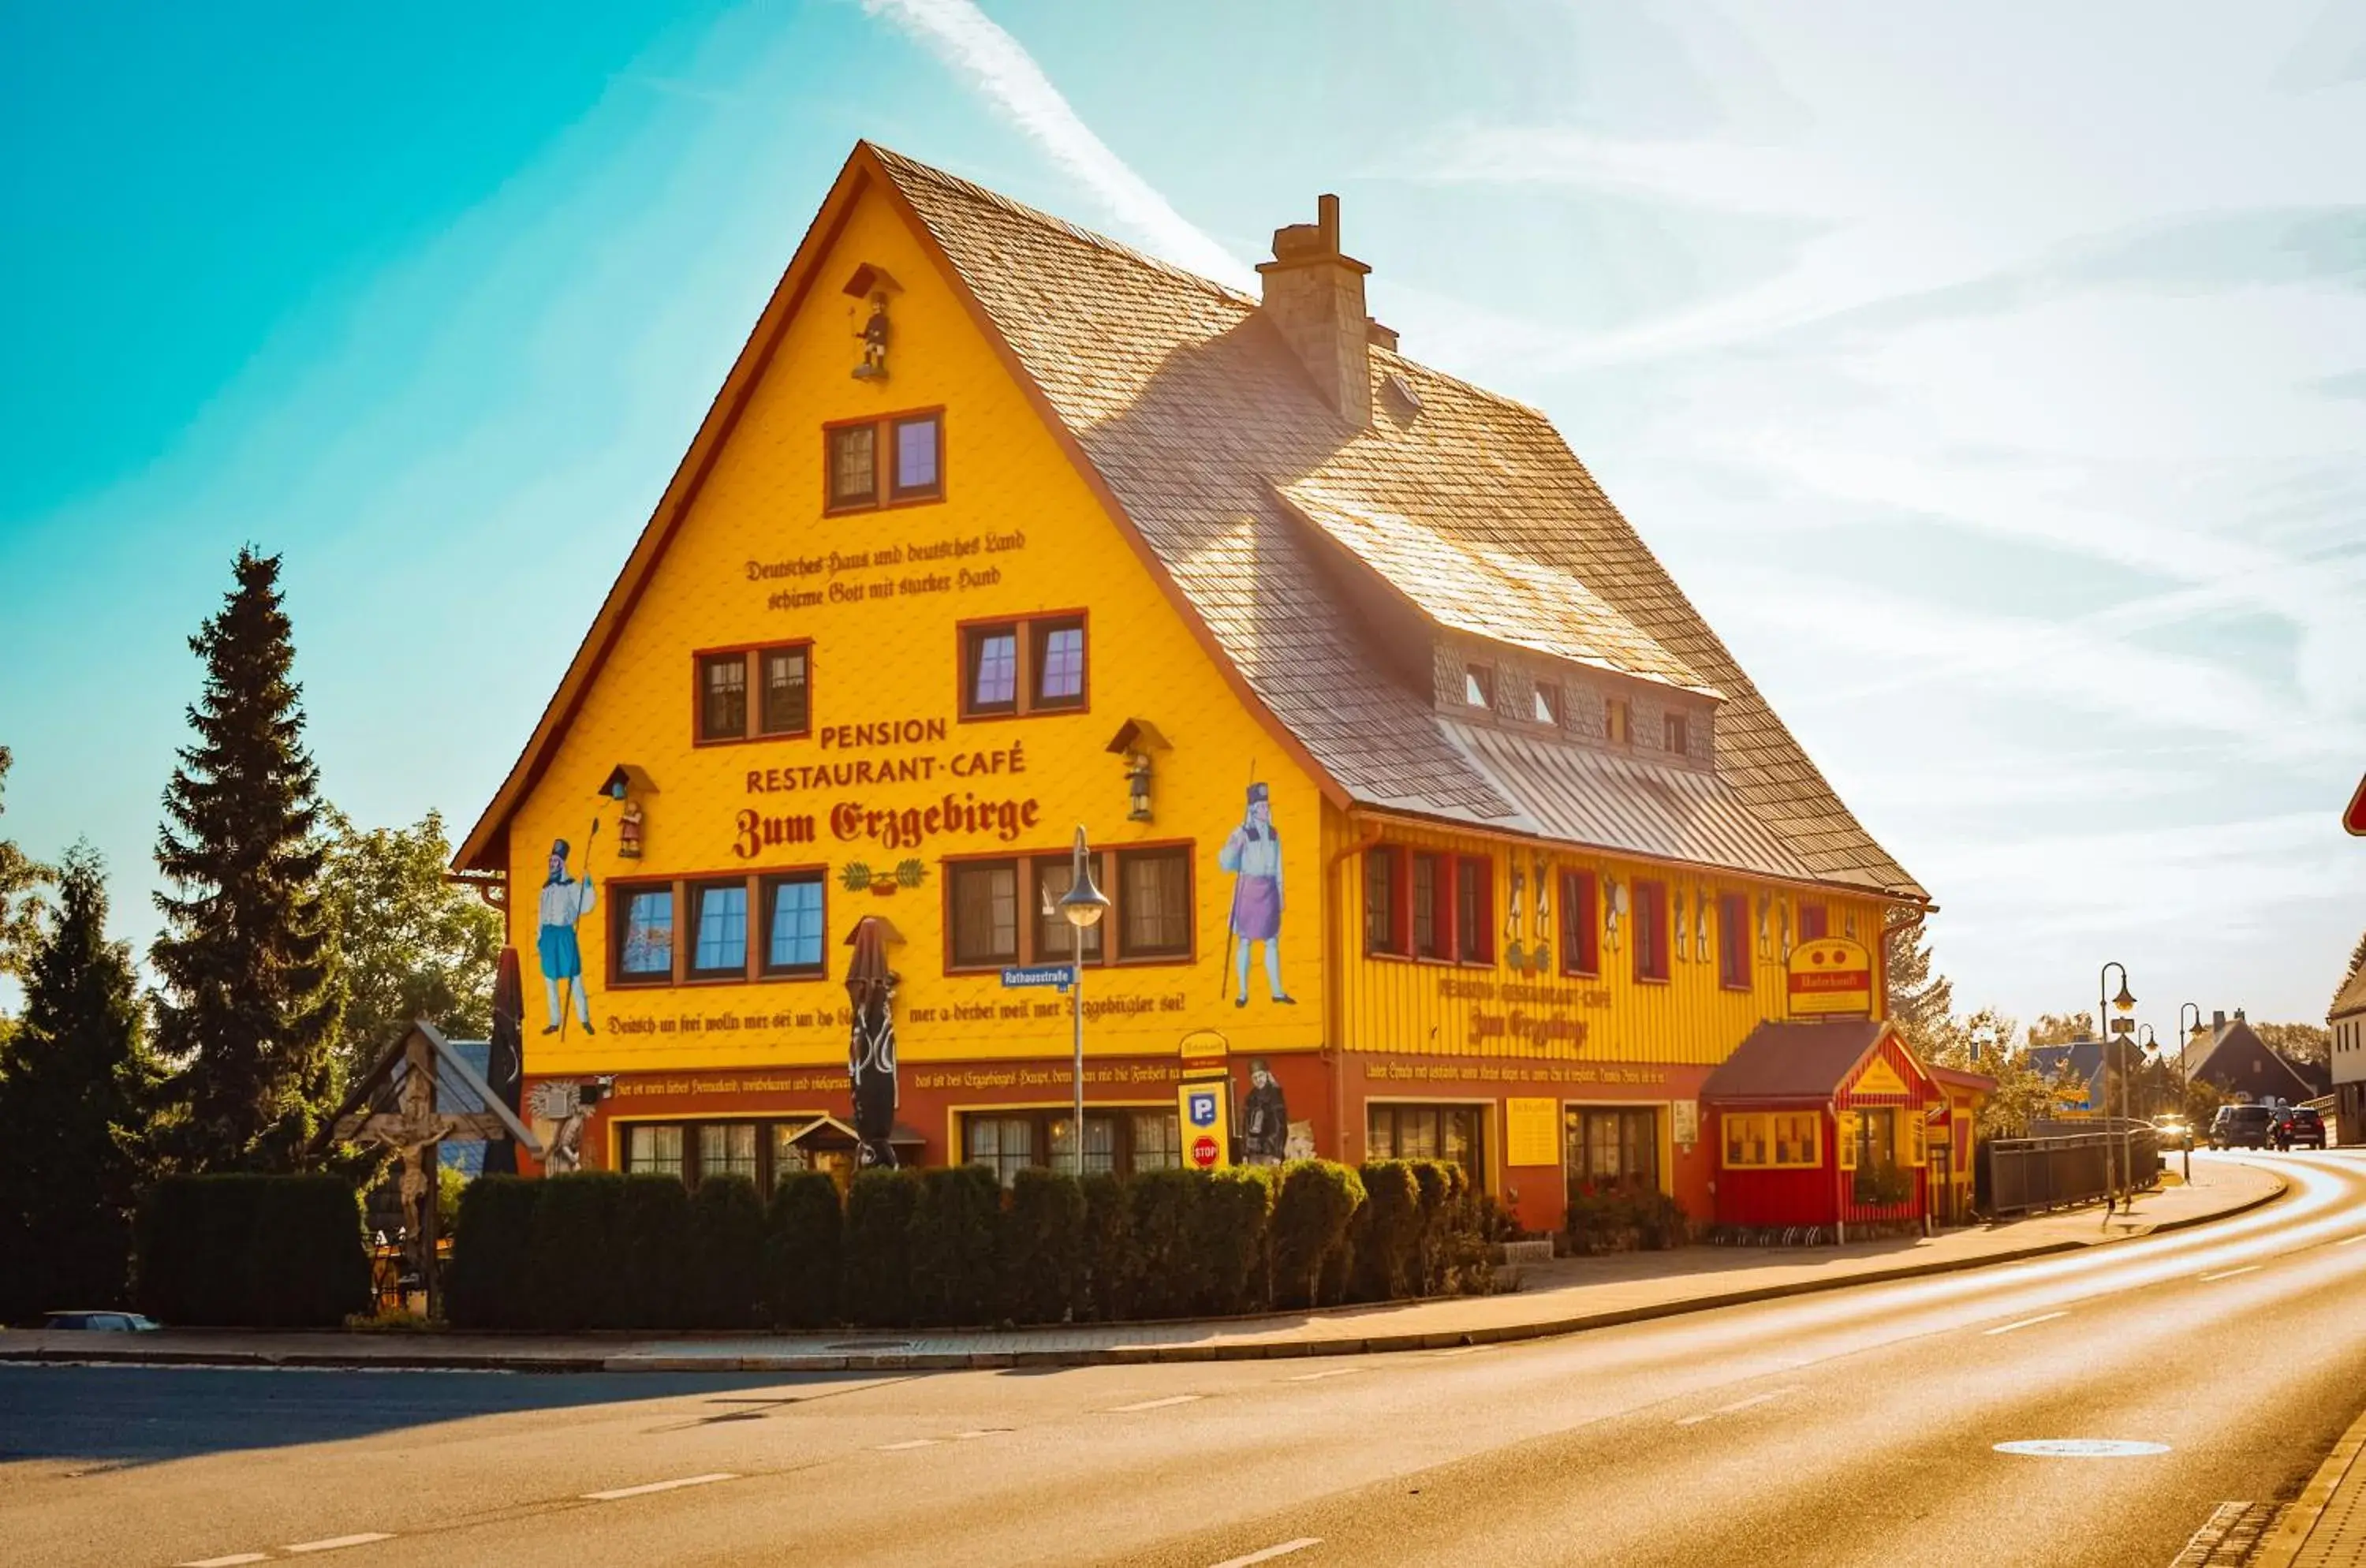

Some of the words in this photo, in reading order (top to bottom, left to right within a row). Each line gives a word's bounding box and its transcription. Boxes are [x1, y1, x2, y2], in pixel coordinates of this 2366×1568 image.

[745, 556, 823, 581] Deutsches
[828, 551, 869, 574] Haus
[874, 545, 902, 566] und
[907, 536, 980, 562] deutsches
[985, 529, 1025, 552] Land
[768, 588, 823, 610] schirme
[829, 582, 864, 603] Gott
[869, 577, 894, 598] mit
[899, 573, 950, 595] starker
[957, 566, 1001, 592] Hand
[820, 718, 946, 750] PENSION
[732, 808, 815, 859] Zum
[830, 792, 1040, 849] Erzgebirge
[1005, 969, 1069, 985] Rathausstraße
[1195, 1099, 1212, 1120] P
[1194, 1146, 1216, 1158] STOP
